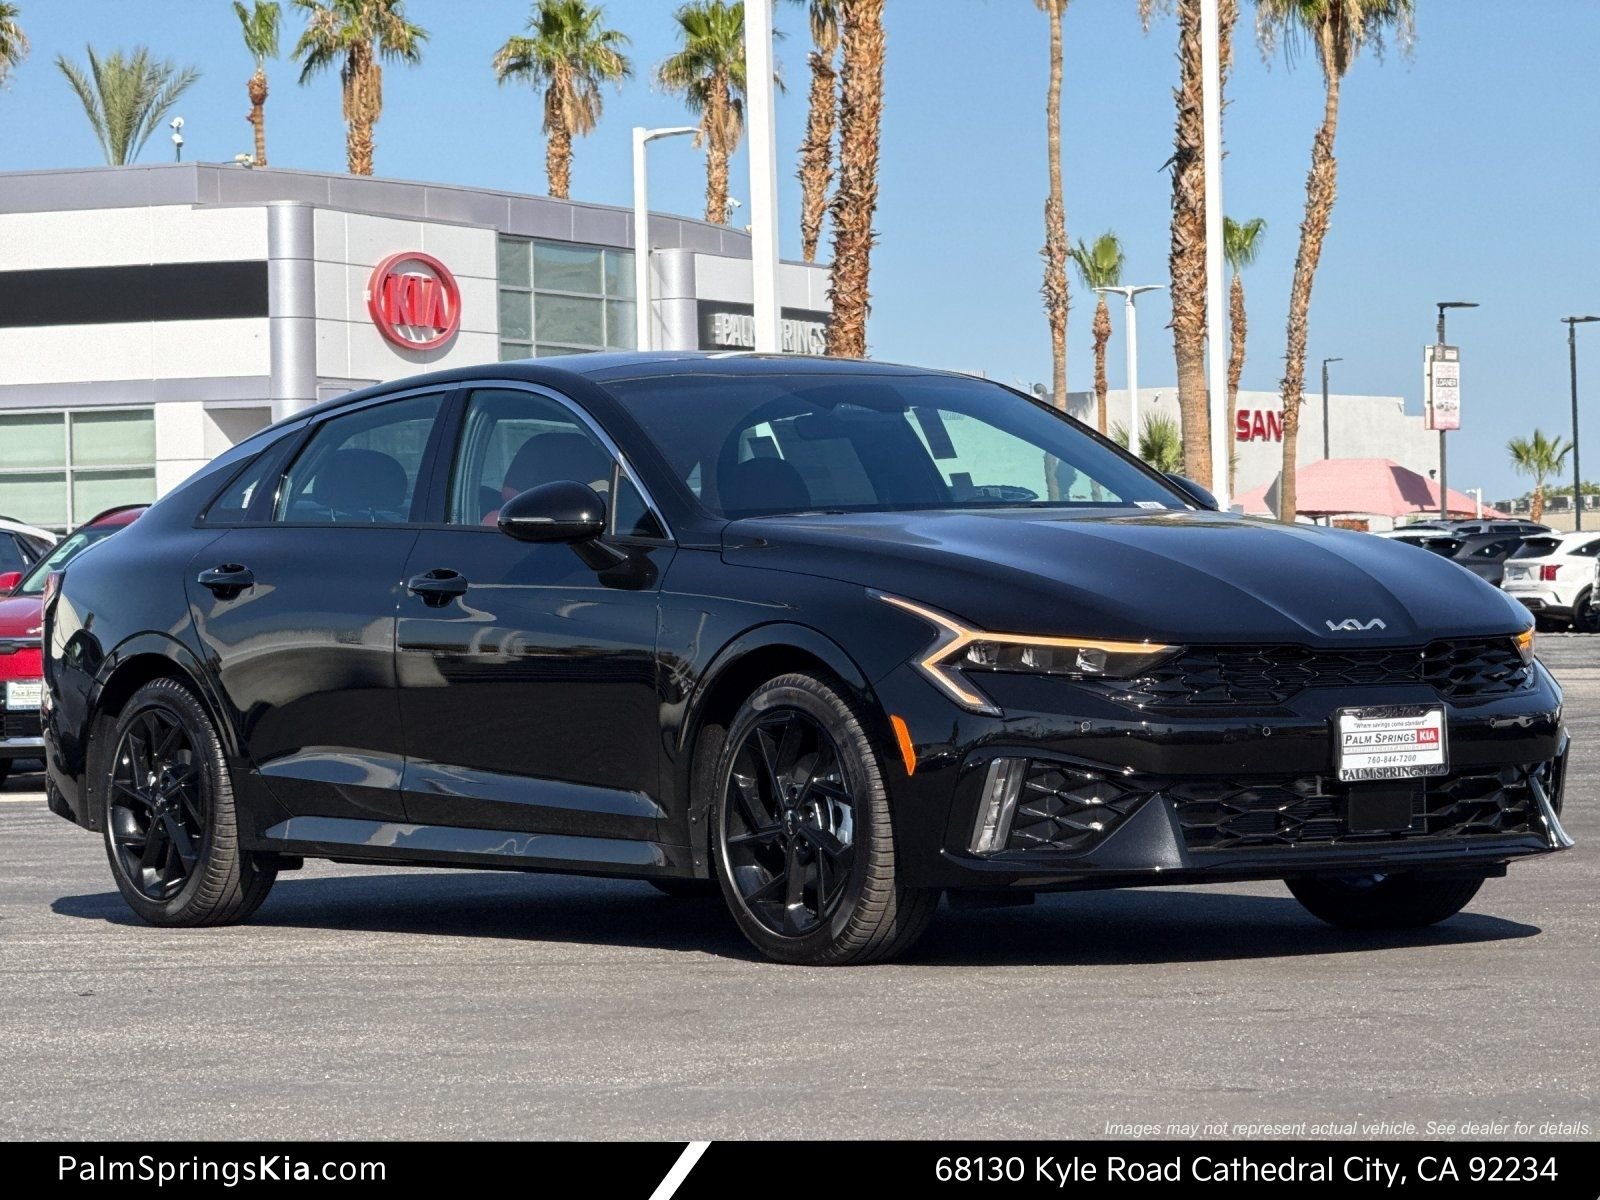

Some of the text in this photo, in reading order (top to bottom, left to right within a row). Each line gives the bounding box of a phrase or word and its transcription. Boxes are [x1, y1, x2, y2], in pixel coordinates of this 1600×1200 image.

[383, 273, 448, 329] KIA
[782, 319, 826, 355] RINGS
[1345, 730, 1436, 744] PALM SPRINGS KIA
[1367, 754, 1417, 764] 760-844-7200
